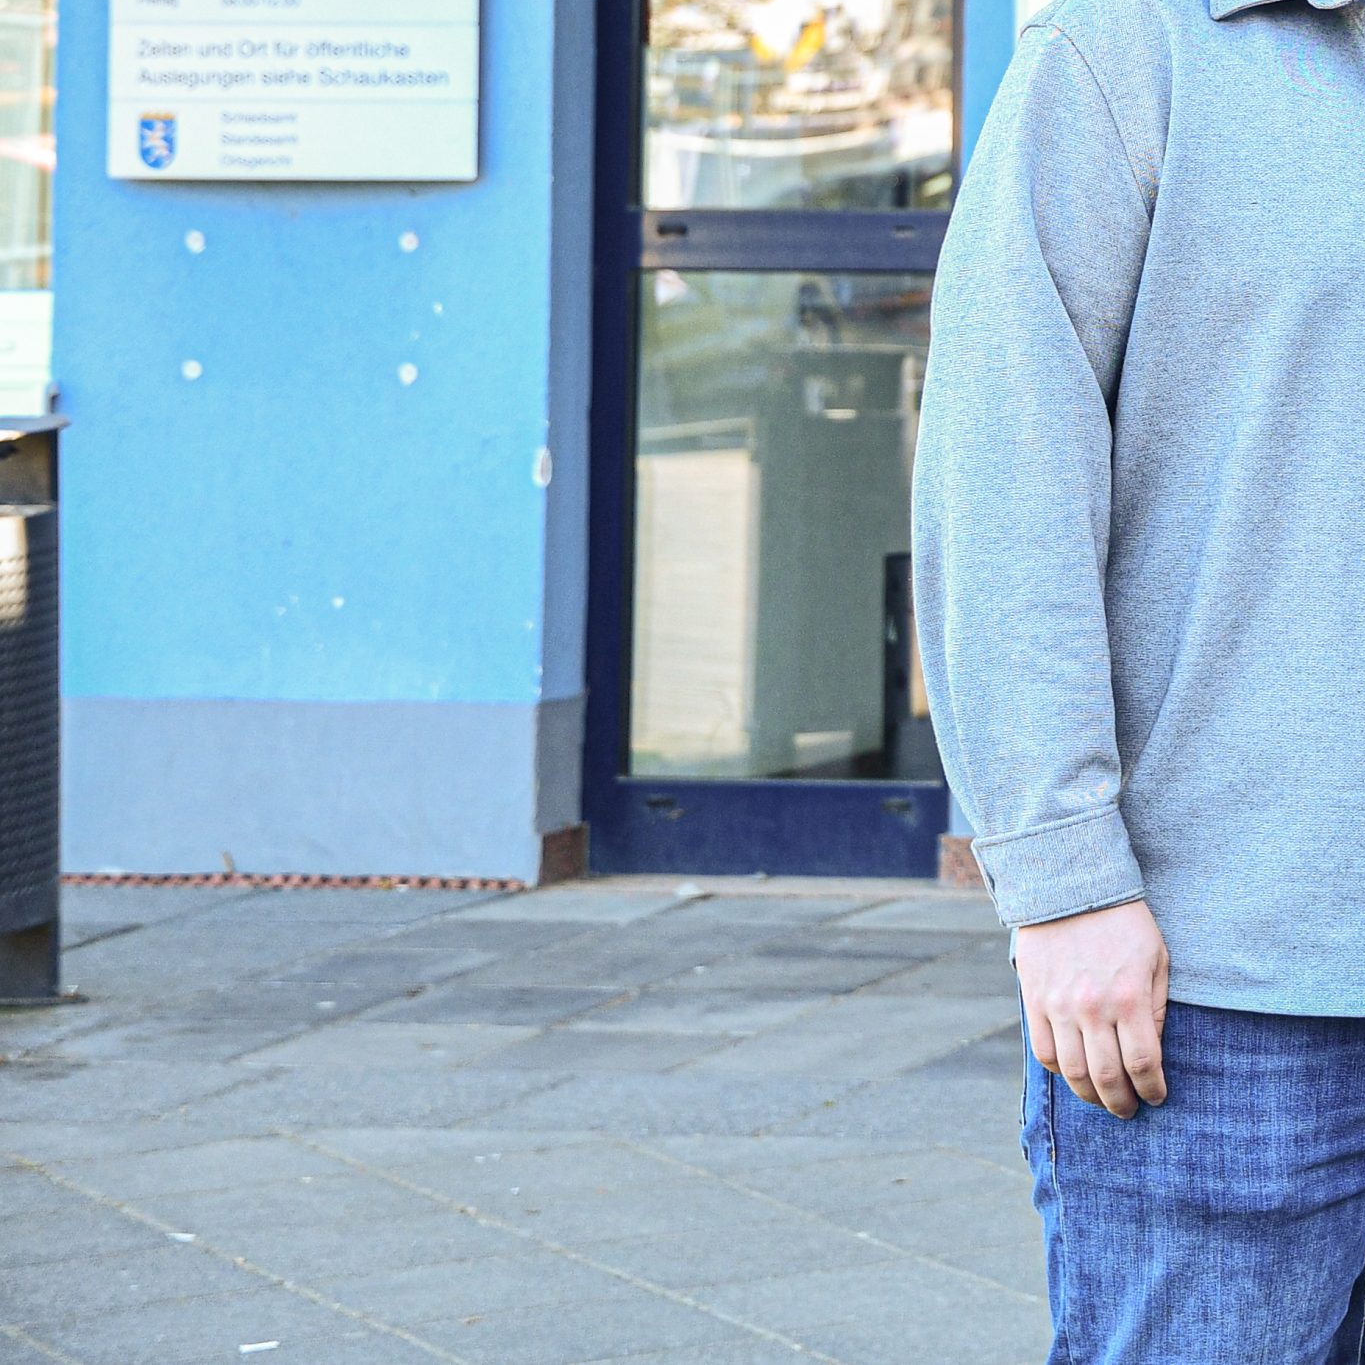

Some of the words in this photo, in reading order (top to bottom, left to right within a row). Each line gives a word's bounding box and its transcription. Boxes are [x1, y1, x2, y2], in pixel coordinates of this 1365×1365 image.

[137, 39, 192, 60] Zeiten
[198, 40, 233, 59] und
[237, 39, 269, 59] Ort
[275, 39, 300, 59] für
[305, 38, 411, 59] öffentliche
[138, 69, 256, 90] Auslegungen
[261, 69, 312, 86] siehe
[319, 68, 450, 87] Schaukasten
